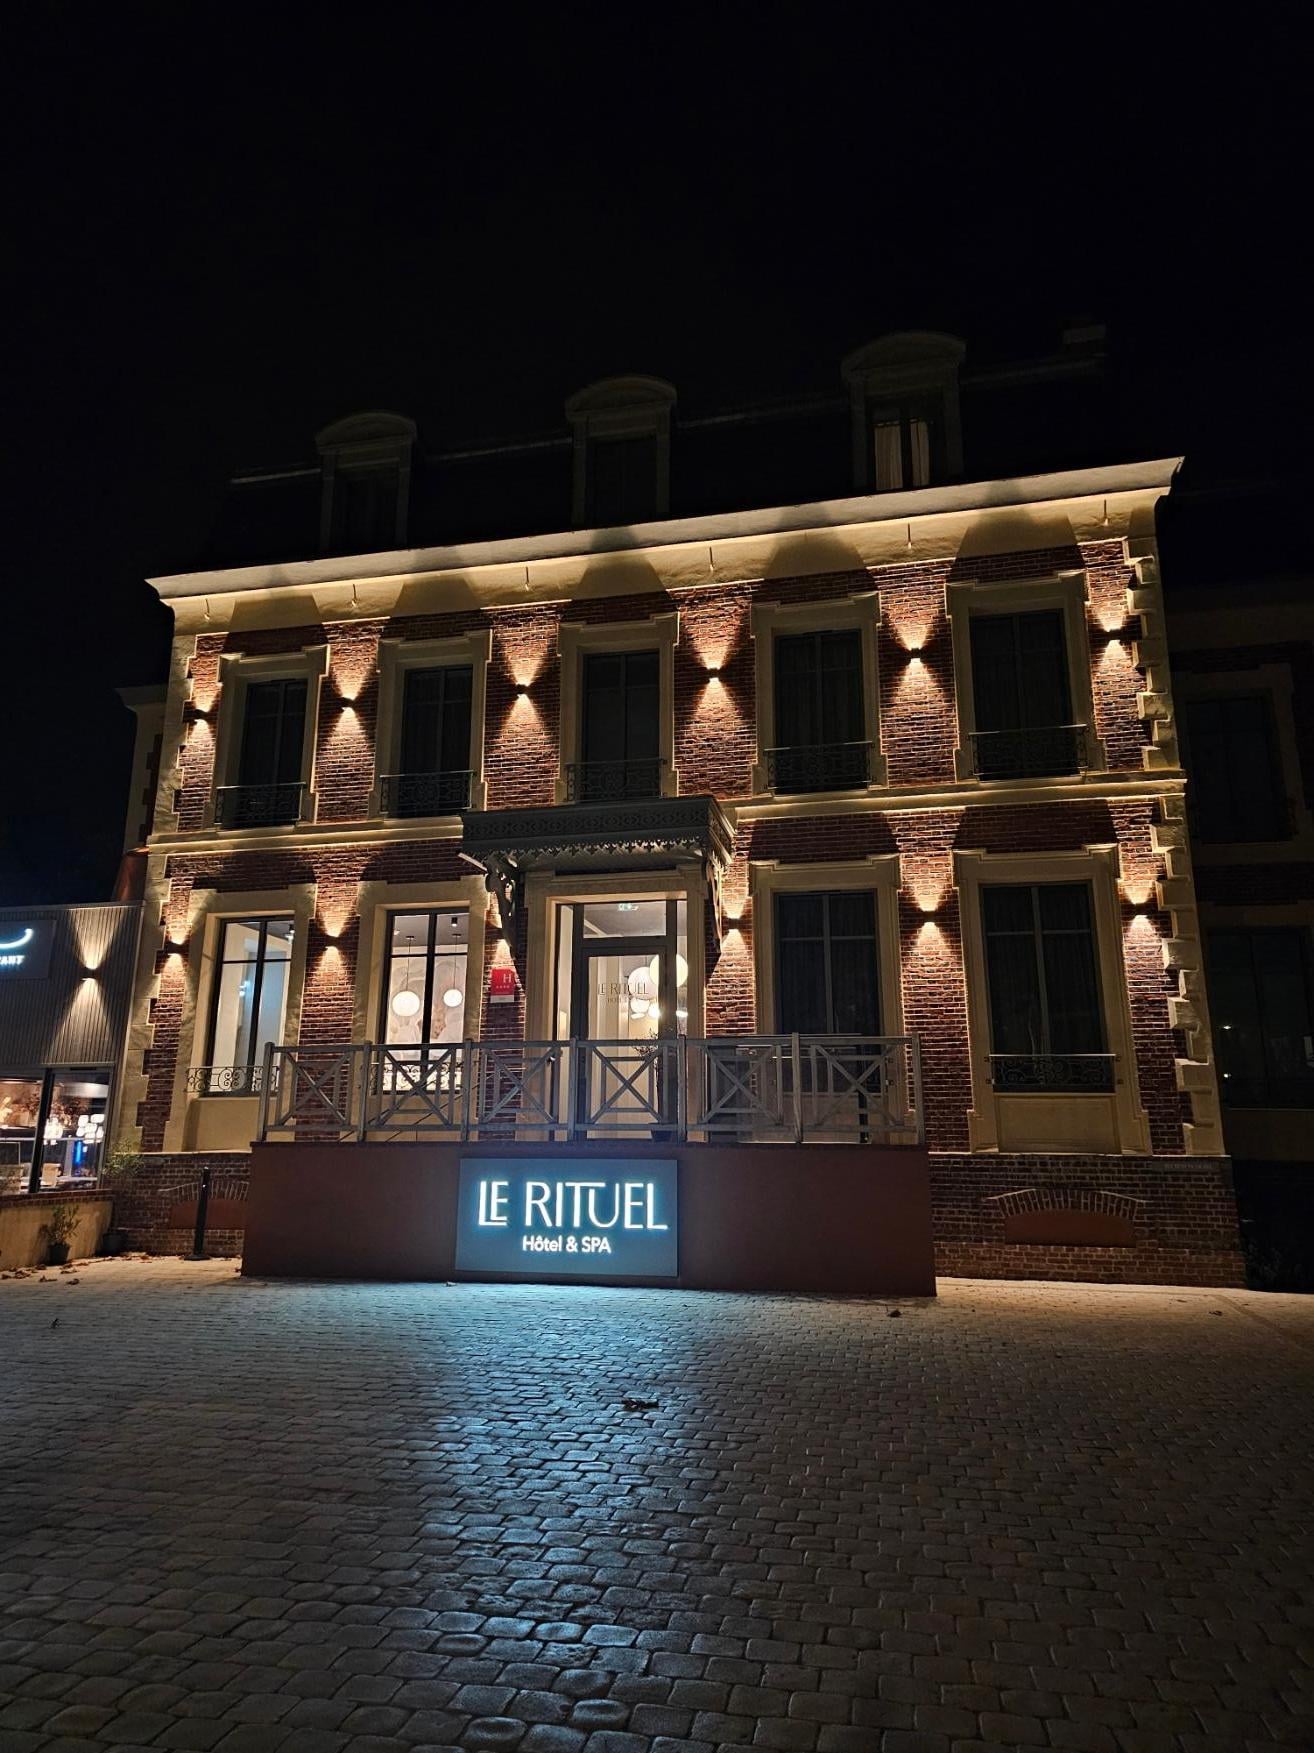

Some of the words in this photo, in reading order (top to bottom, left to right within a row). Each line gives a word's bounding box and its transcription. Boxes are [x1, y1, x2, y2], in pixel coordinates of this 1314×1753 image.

[503, 973, 511, 983] H
[478, 1180, 508, 1226] LE
[524, 1181, 668, 1230] RITUEL
[522, 1235, 562, 1252] Hôtel
[566, 1237, 578, 1253] &
[581, 1237, 612, 1254] SPA
